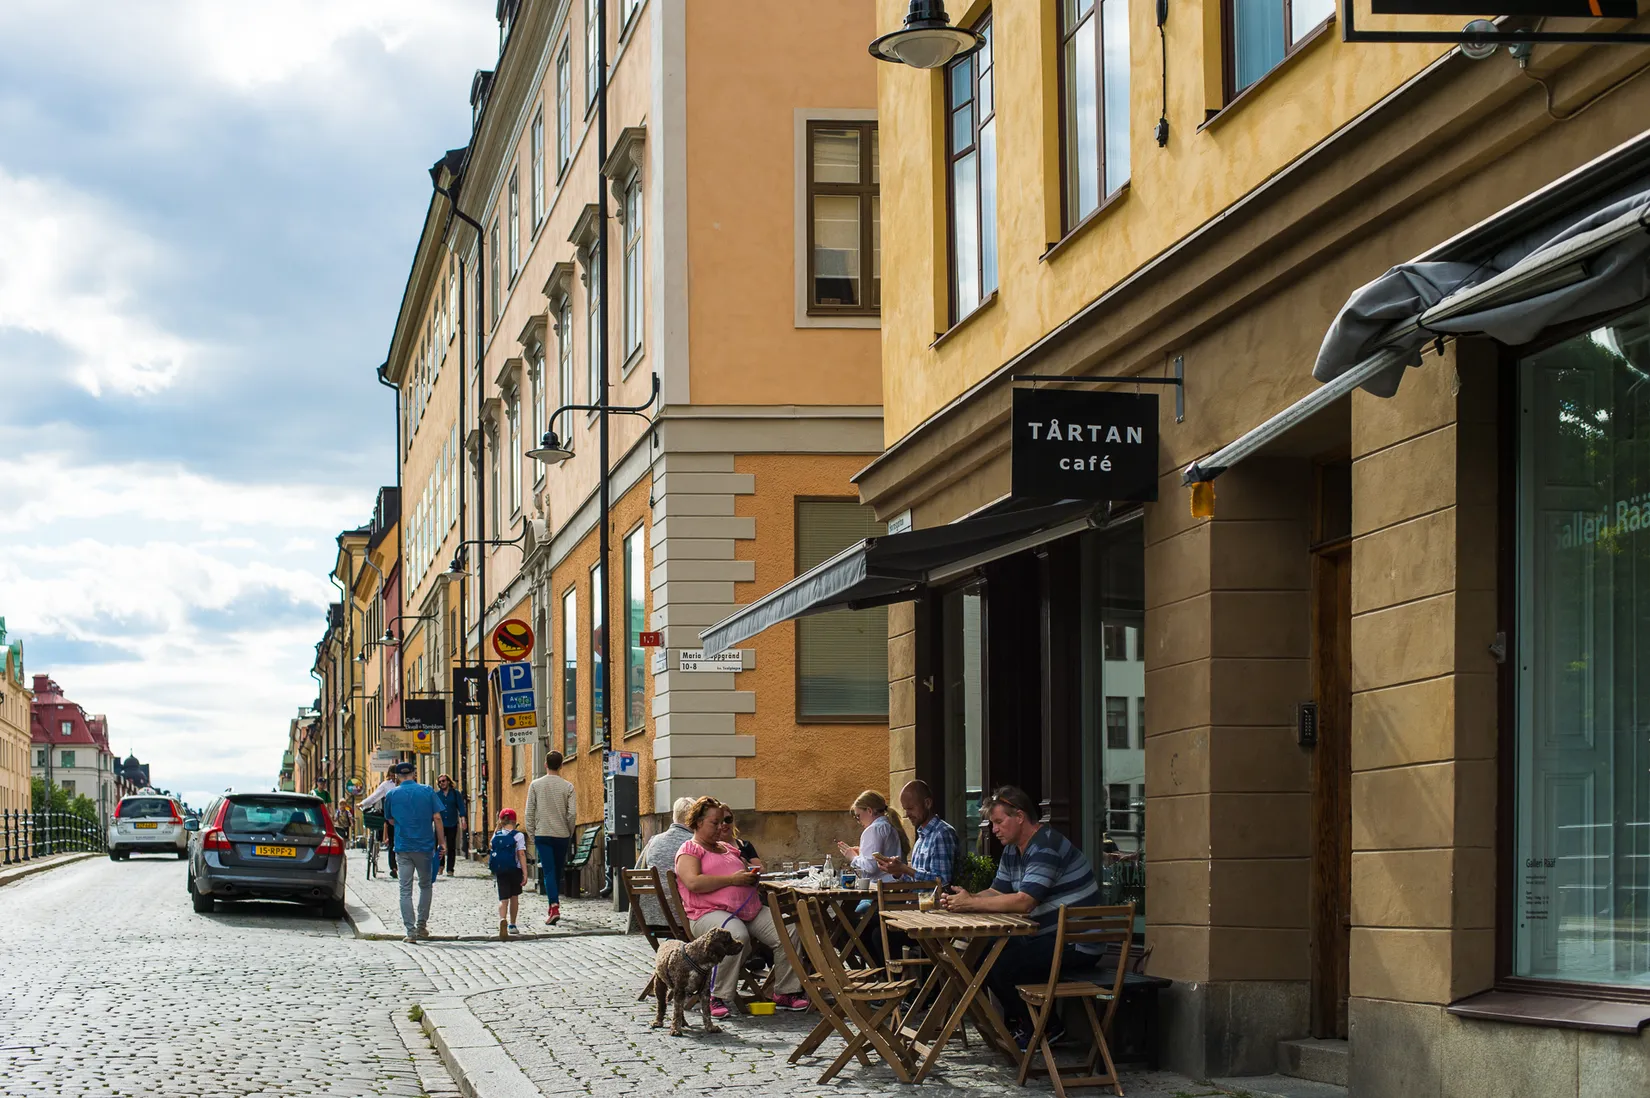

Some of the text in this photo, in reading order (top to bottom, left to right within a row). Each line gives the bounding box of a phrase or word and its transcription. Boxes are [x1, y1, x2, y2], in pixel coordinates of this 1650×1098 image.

[1028, 418, 1143, 445] TÅRTAN
[1059, 455, 1112, 472] café
[682, 651, 702, 659] Maria
[682, 662, 698, 670] 10-8
[509, 665, 525, 689] P
[259, 846, 293, 856] 15-RPF-2
[1525, 858, 1543, 868] Galleri
